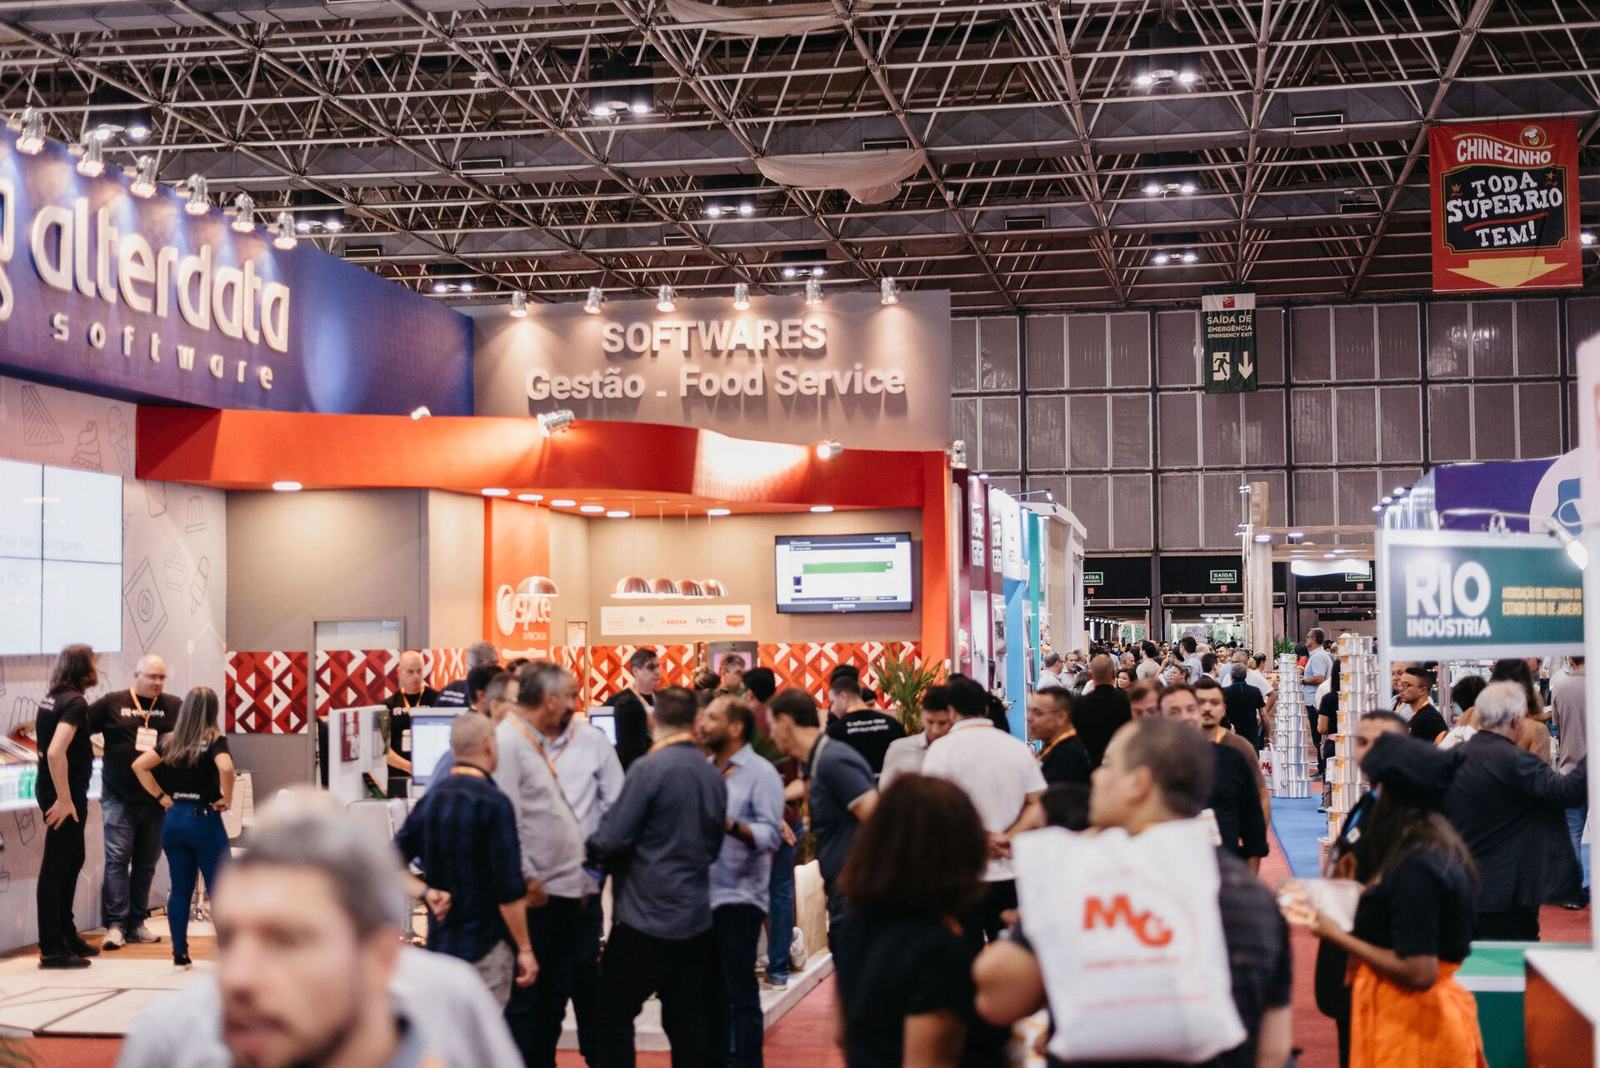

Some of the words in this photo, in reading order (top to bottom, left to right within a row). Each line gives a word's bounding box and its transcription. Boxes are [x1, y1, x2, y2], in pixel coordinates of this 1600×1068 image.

[1456, 138, 1552, 164] CHINEZINHO
[1471, 171, 1537, 198] TODA
[1446, 187, 1563, 223] SUPERRIO
[1476, 220, 1536, 247] TEM!
[31, 197, 290, 352] alterdata
[1207, 315, 1236, 324] SAÍDA
[1238, 314, 1252, 322] DE
[1208, 325, 1253, 333] EMERGÊNCIA
[50, 312, 275, 389] software
[601, 319, 827, 353] SOFTWARES
[526, 366, 646, 400] Gestão
[679, 363, 764, 397] Food
[774, 362, 906, 396] Service
[1406, 560, 1491, 616] RIO
[1407, 616, 1492, 638] INDÚSTRIA
